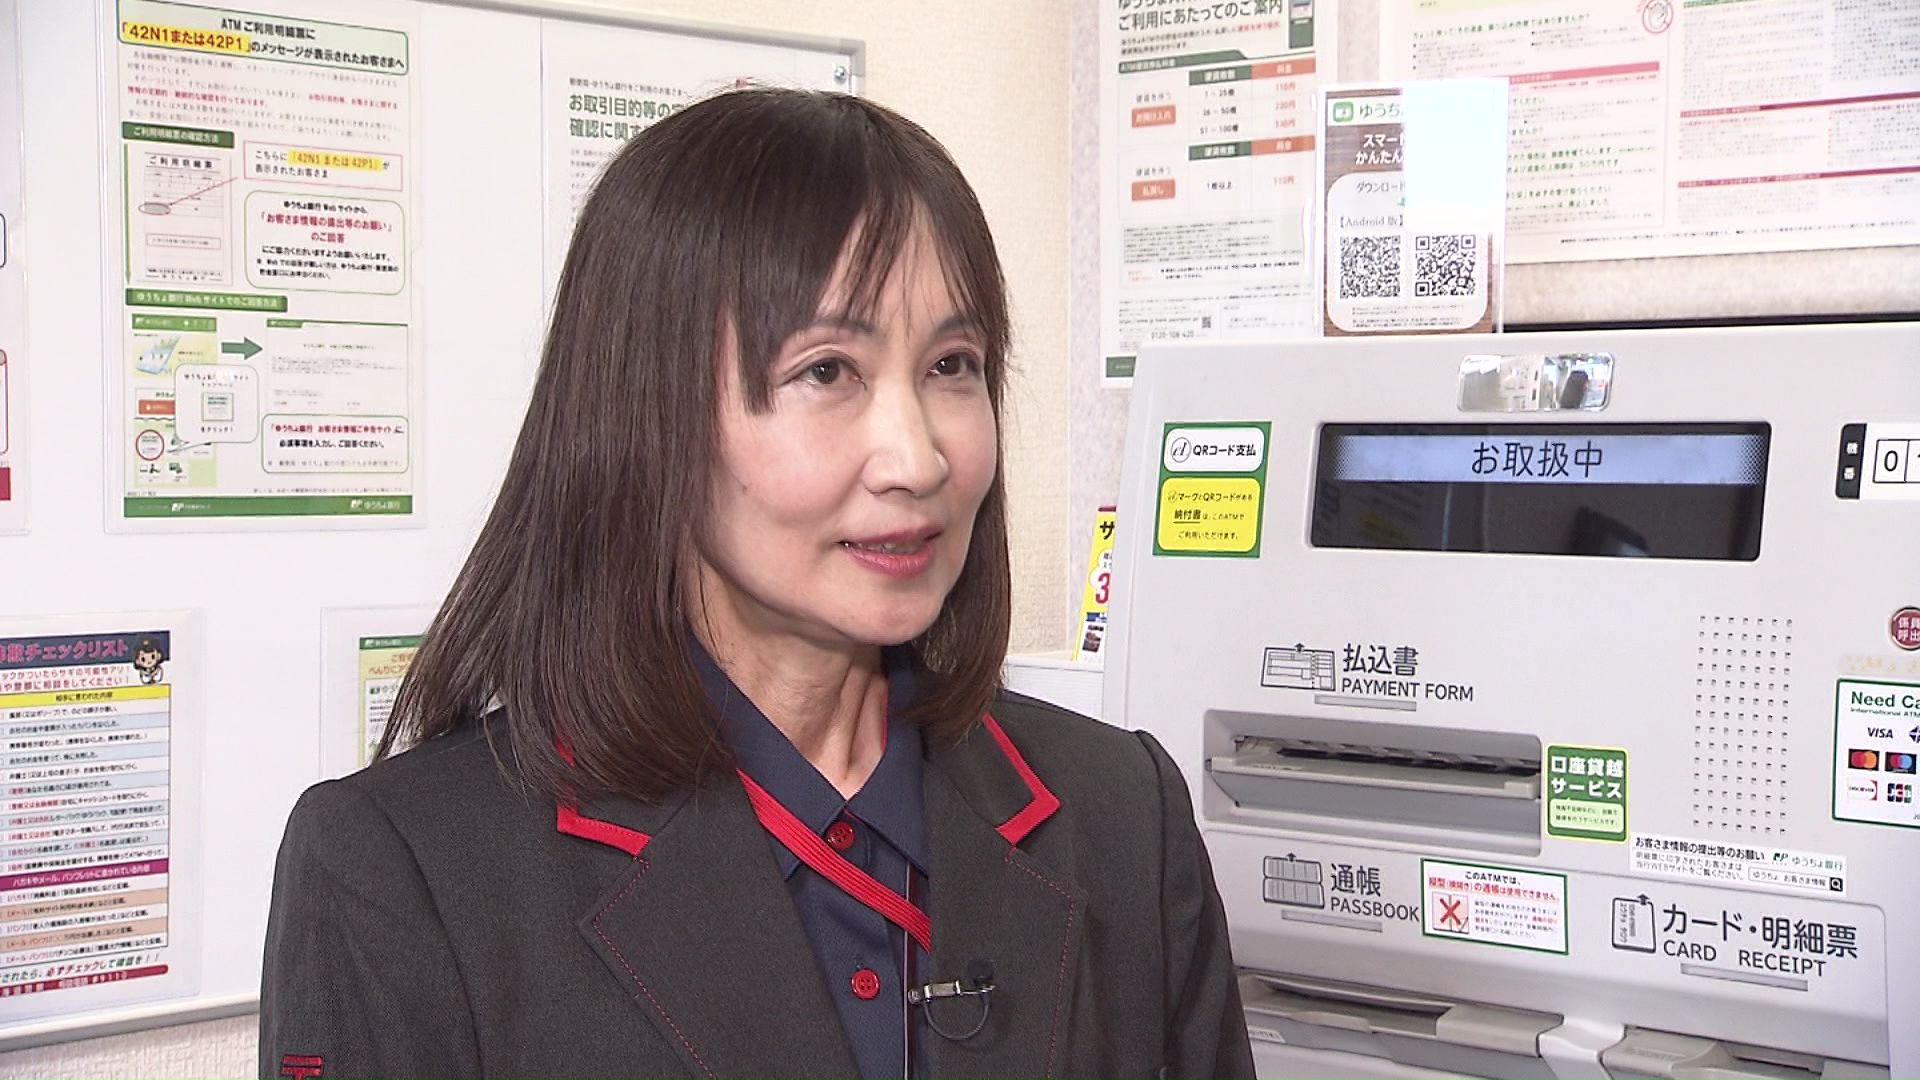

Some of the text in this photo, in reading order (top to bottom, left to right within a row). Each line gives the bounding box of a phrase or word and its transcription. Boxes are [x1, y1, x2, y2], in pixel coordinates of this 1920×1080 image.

[1119, 1, 1283, 31] ご利用にあたってのご案内
[1360, 103, 1404, 119] ゆうち
[569, 118, 643, 140] 確認に関す
[1193, 443, 1256, 457] QRコード支払
[1471, 440, 1603, 479] お取扱中
[1342, 643, 1419, 677] 払込書
[0, 677, 129, 692] や警察に相談をしてください！
[1341, 677, 1474, 701] PAYMENT FORM
[1851, 690, 1896, 707] Need
[1867, 727, 1894, 739] VISA
[1551, 755, 1624, 779] 口座貸越
[1551, 777, 1623, 800] サービス
[1635, 836, 1765, 861] お客さま情報の提出等のお願い
[1791, 857, 1844, 871] ゆうちょ銀行
[1329, 863, 1383, 898] 通帳
[1464, 870, 1522, 886] このATMでは、
[1329, 896, 1421, 922] PASSBOOK
[1662, 902, 1859, 960] カード・明細票
[1663, 939, 1828, 978] CARD RECEIPT
